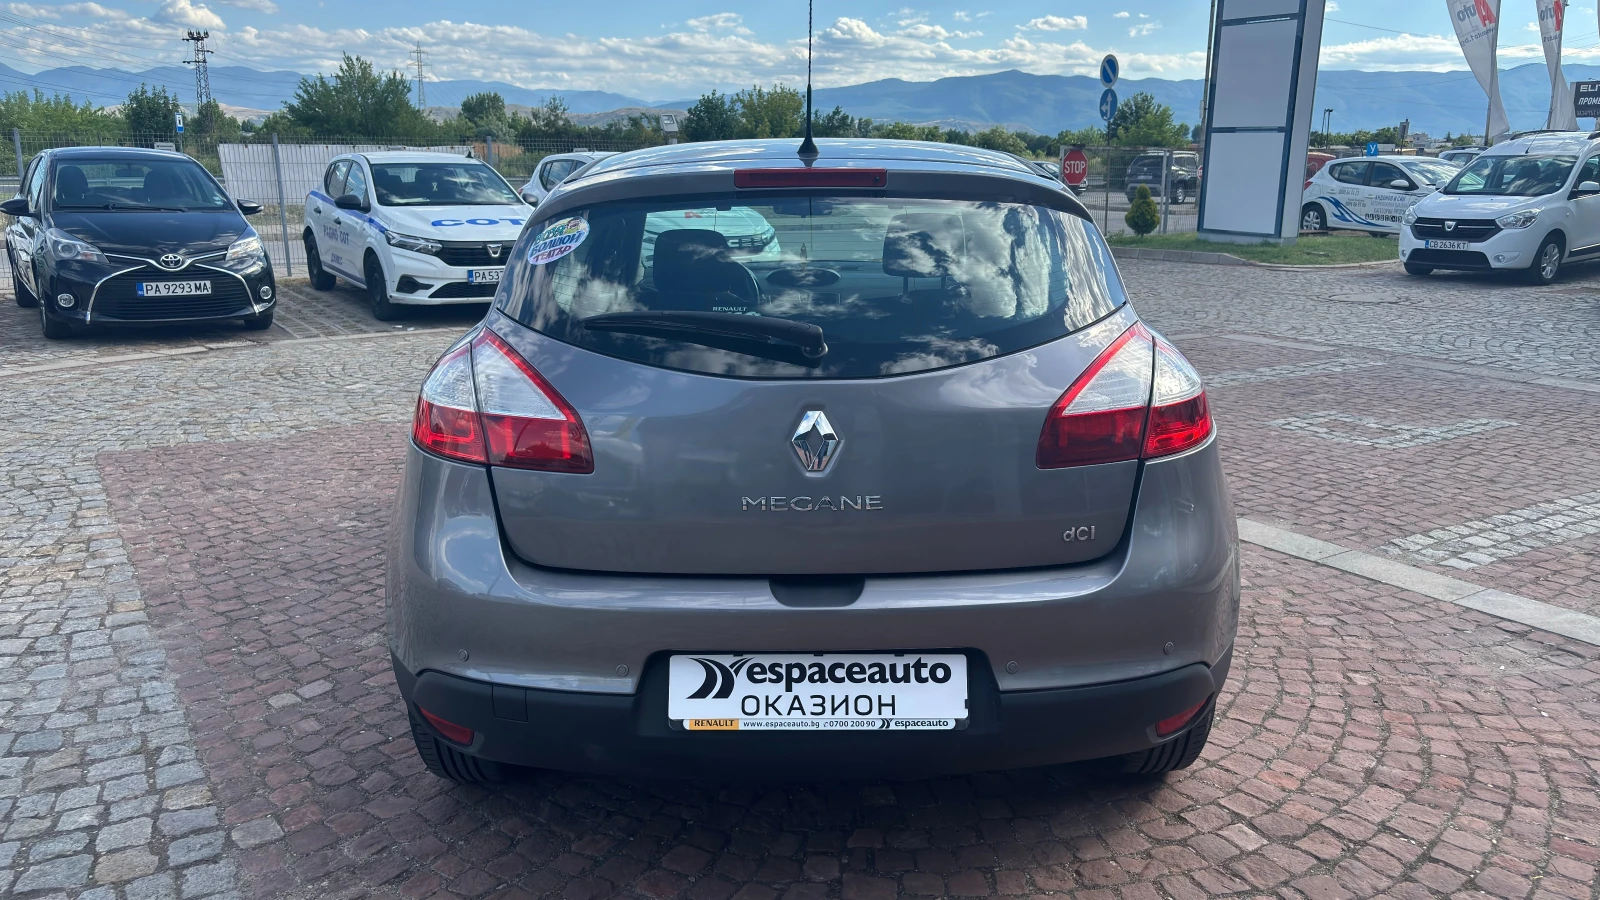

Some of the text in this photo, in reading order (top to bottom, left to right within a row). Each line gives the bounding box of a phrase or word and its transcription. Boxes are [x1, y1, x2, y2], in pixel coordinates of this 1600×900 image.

[1064, 160, 1086, 174] STOP
[1440, 241, 1456, 249] 2636
[145, 284, 162, 295] PA
[163, 283, 192, 294] 9293
[194, 282, 209, 293] MA
[741, 495, 884, 512] MEGANE
[746, 656, 953, 692] espaceauto
[740, 694, 897, 716] ОКАЗИОН
[694, 719, 735, 727] RENAULT
[743, 720, 820, 729] www.espaceauto.bg
[829, 720, 849, 728] 0700
[894, 720, 949, 729] espaceauto
